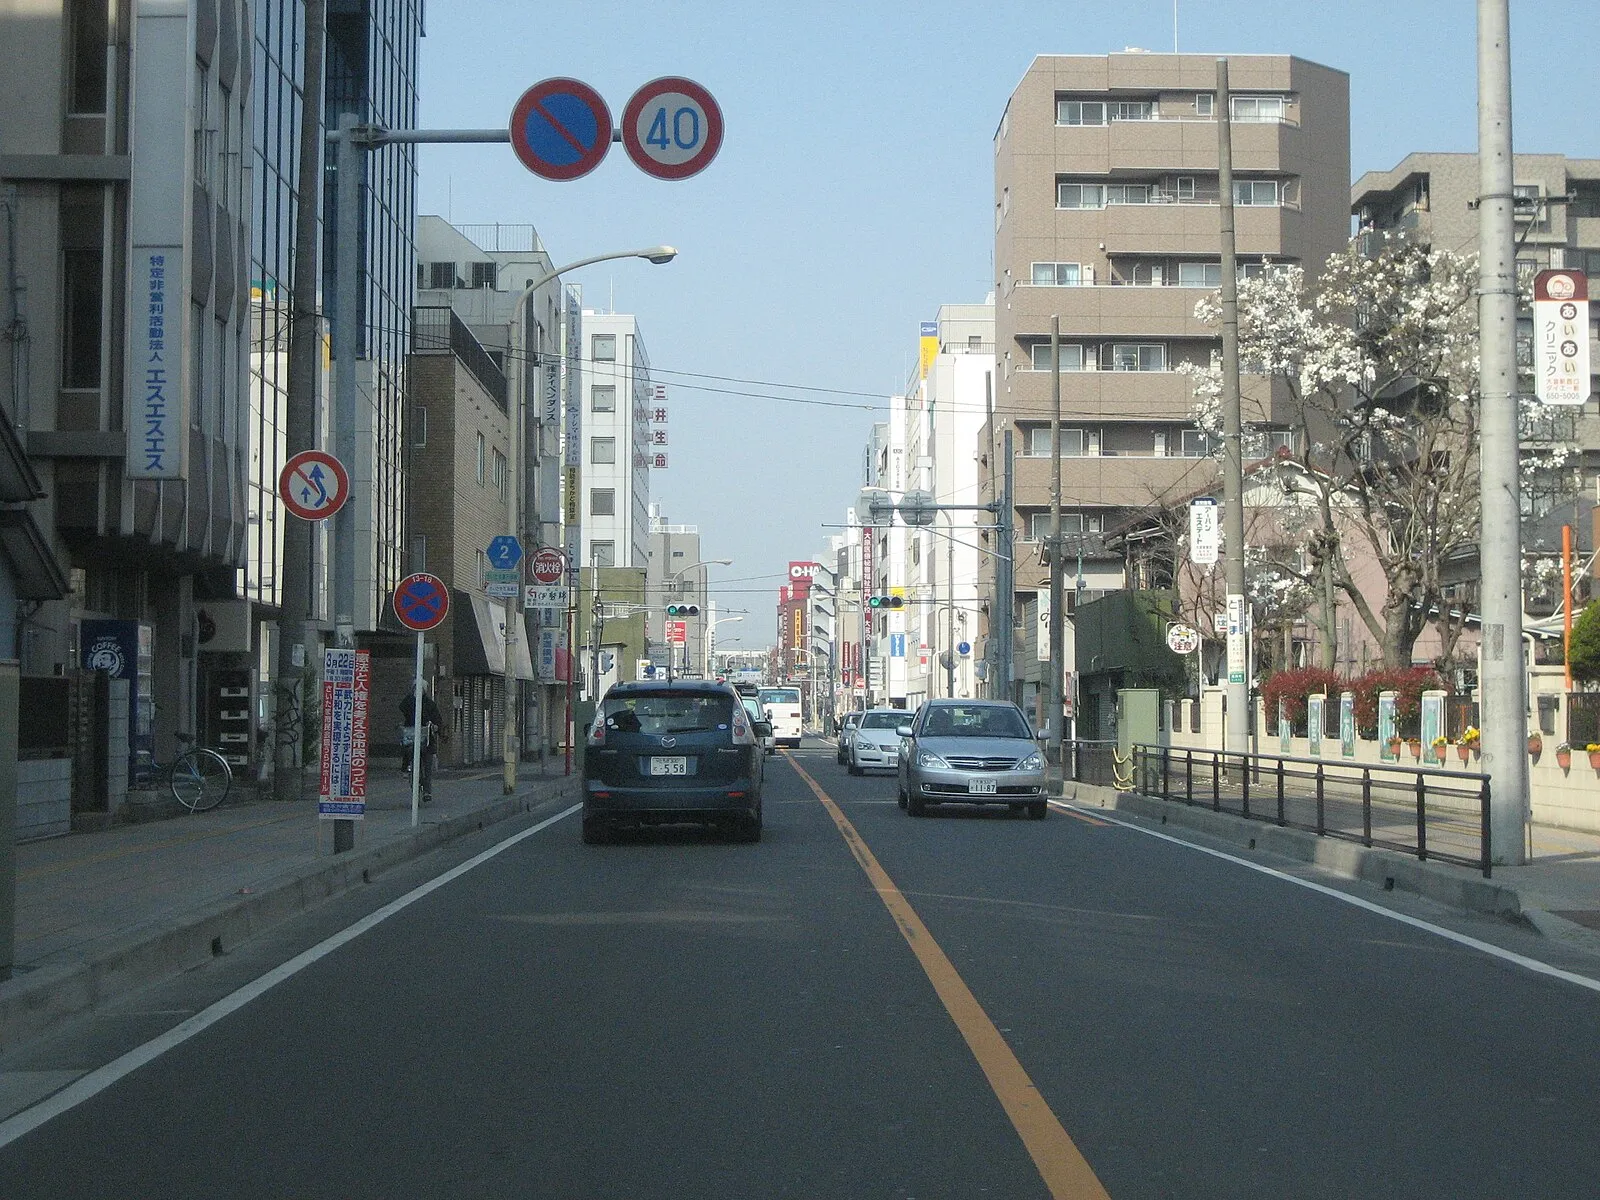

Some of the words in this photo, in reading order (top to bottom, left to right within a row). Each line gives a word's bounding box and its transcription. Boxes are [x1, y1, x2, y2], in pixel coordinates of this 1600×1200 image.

[646, 107, 699, 150] 40
[1545, 320, 1557, 376] クリニック
[1561, 304, 1577, 373] あいあい
[145, 369, 167, 471] エスエスエス
[655, 385, 667, 467] 三井生命
[1196, 513, 1204, 545] エステート
[500, 545, 509, 559] 2
[535, 561, 561, 574] 消火栓
[791, 566, 821, 578] O-HA
[91, 641, 121, 653] COFFEE
[1174, 641, 1192, 651] 注意
[342, 689, 353, 763] 武力によらずに
[975, 784, 996, 792] 11-87
